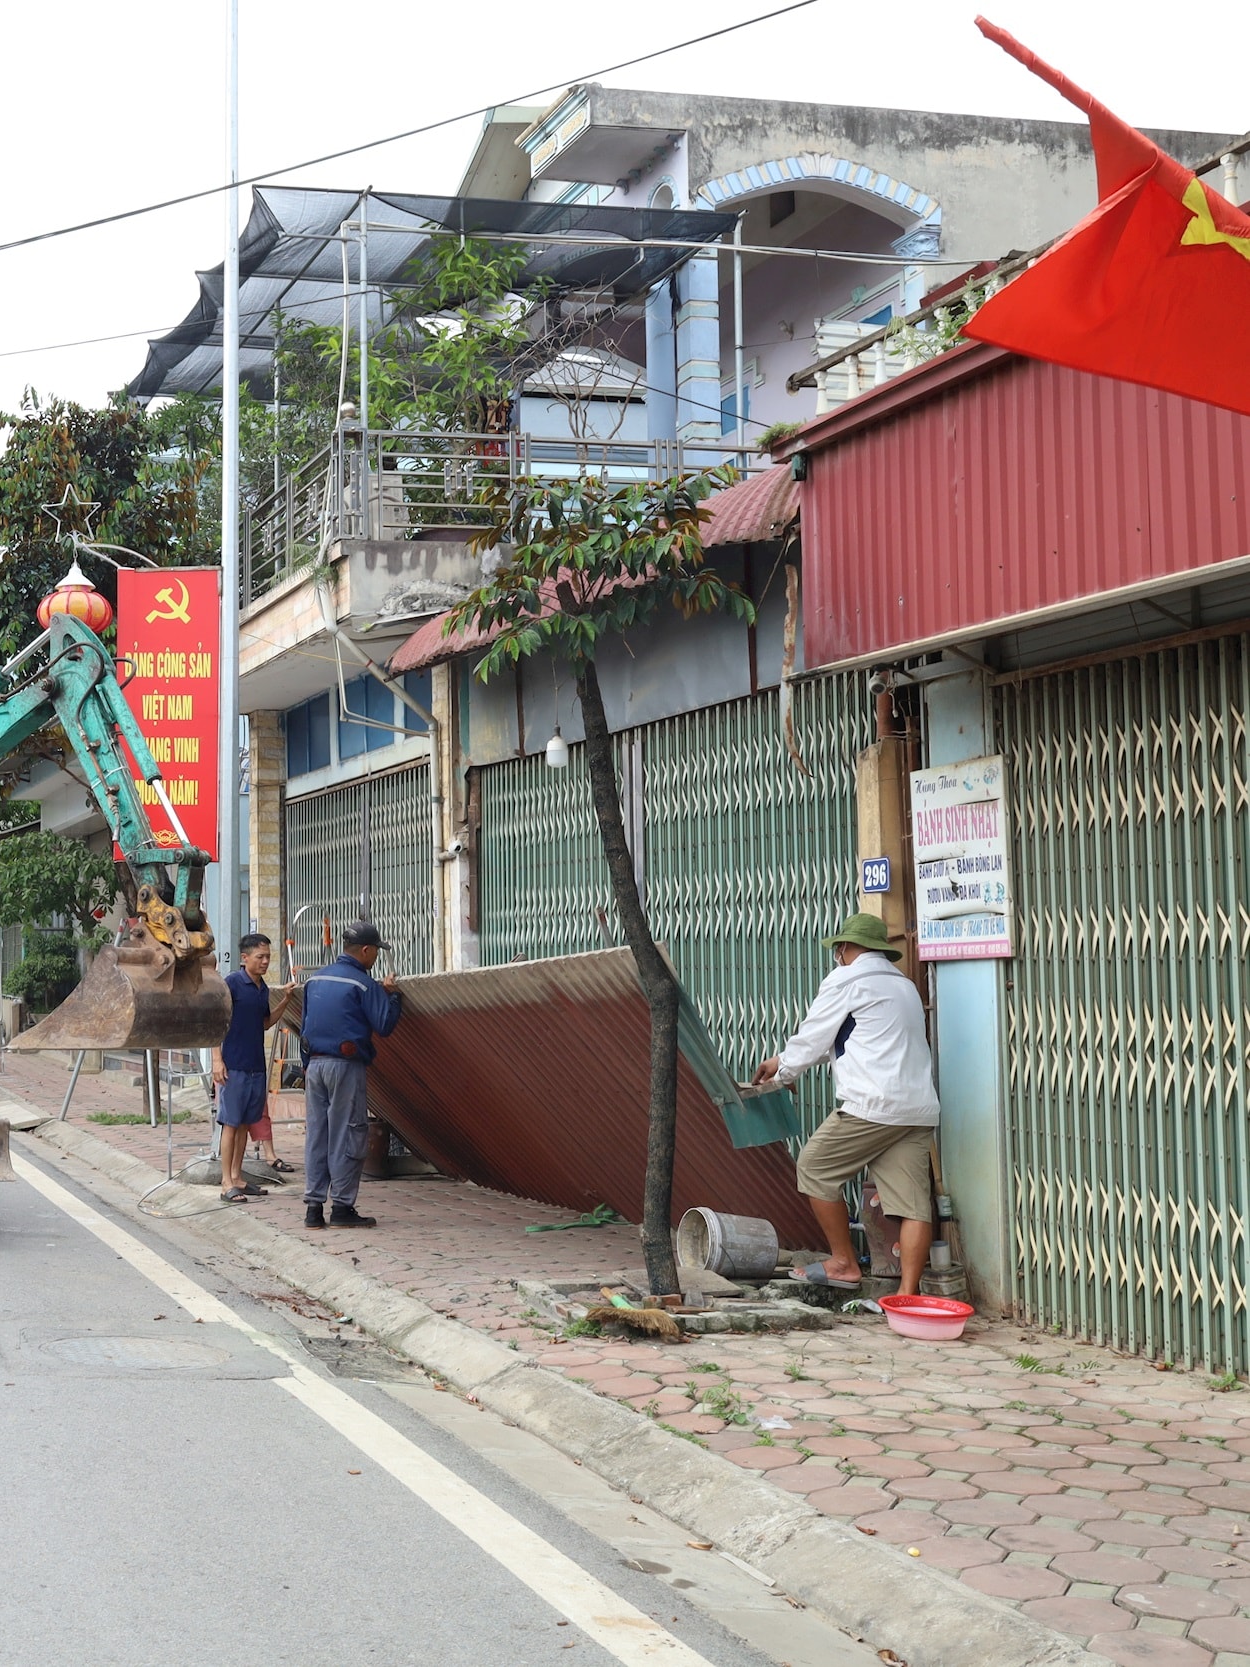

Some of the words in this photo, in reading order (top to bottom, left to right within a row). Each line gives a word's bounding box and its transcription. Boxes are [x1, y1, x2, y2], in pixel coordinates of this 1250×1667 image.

[124, 641, 154, 678] ĐẢNG
[157, 647, 186, 683] CỘNG
[189, 641, 211, 678] SẢN
[142, 689, 165, 726] VIỆT
[167, 694, 193, 720] NAM
[144, 737, 171, 763] ANG
[174, 737, 199, 763] VINH
[170, 774, 199, 806] NĂM!
[938, 775, 958, 790] Thoa
[917, 799, 943, 846] BÁNH
[945, 804, 969, 843] SINH
[865, 863, 887, 887] 296
[991, 854, 1003, 871] LAN
